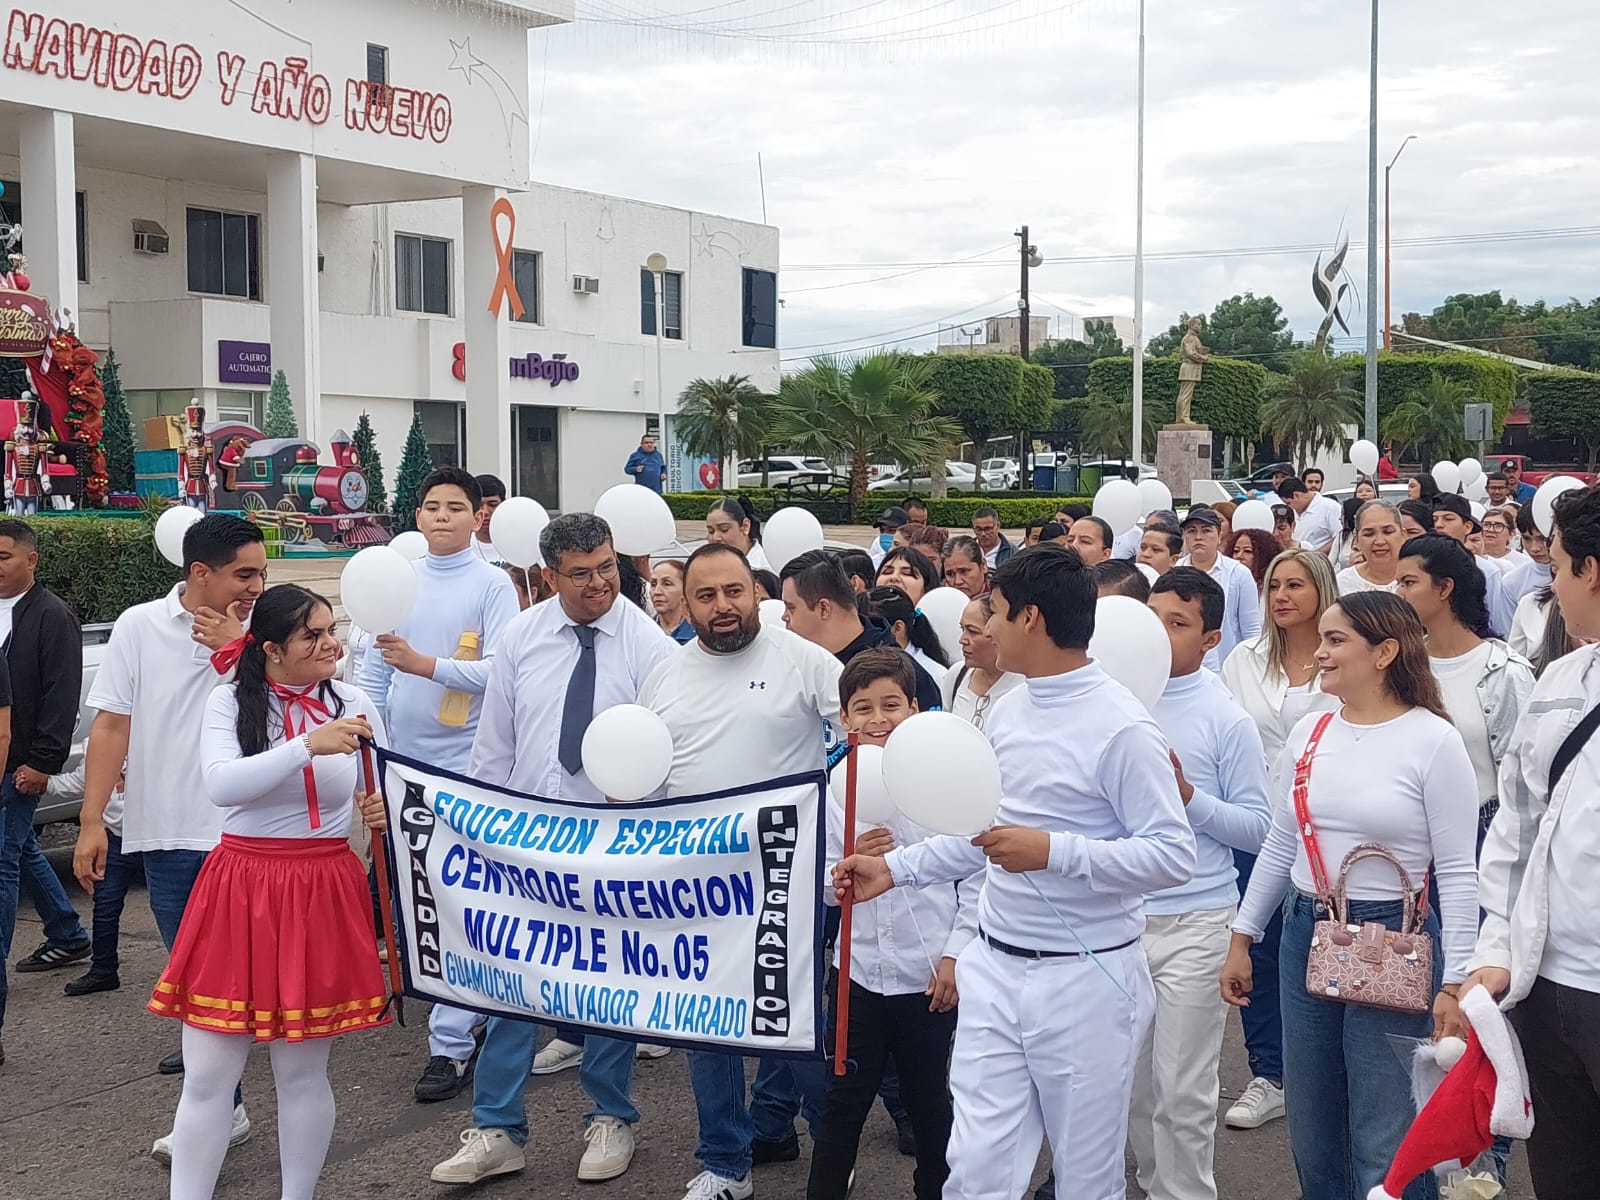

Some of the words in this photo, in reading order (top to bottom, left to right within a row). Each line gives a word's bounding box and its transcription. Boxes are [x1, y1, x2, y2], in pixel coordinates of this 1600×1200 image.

[3, 9, 202, 100] NAVIDAD
[217, 51, 245, 105] Y
[251, 57, 331, 126] AÑO
[344, 78, 452, 143] NUEVO
[228, 363, 271, 374] AUTOMATIC
[239, 352, 267, 362] CAJERO
[434, 791, 599, 854] EDUCACION
[605, 813, 750, 855] ESPECIAL
[594, 871, 754, 919] ATENCION
[755, 811, 796, 1033] INTEGRACION
[464, 908, 607, 972] MULTIPLE
[674, 933, 709, 981] 05
[446, 951, 537, 1012] GUAMUCHIL,
[540, 980, 639, 1027] SALVADOR
[647, 991, 747, 1039] ALVARADO
